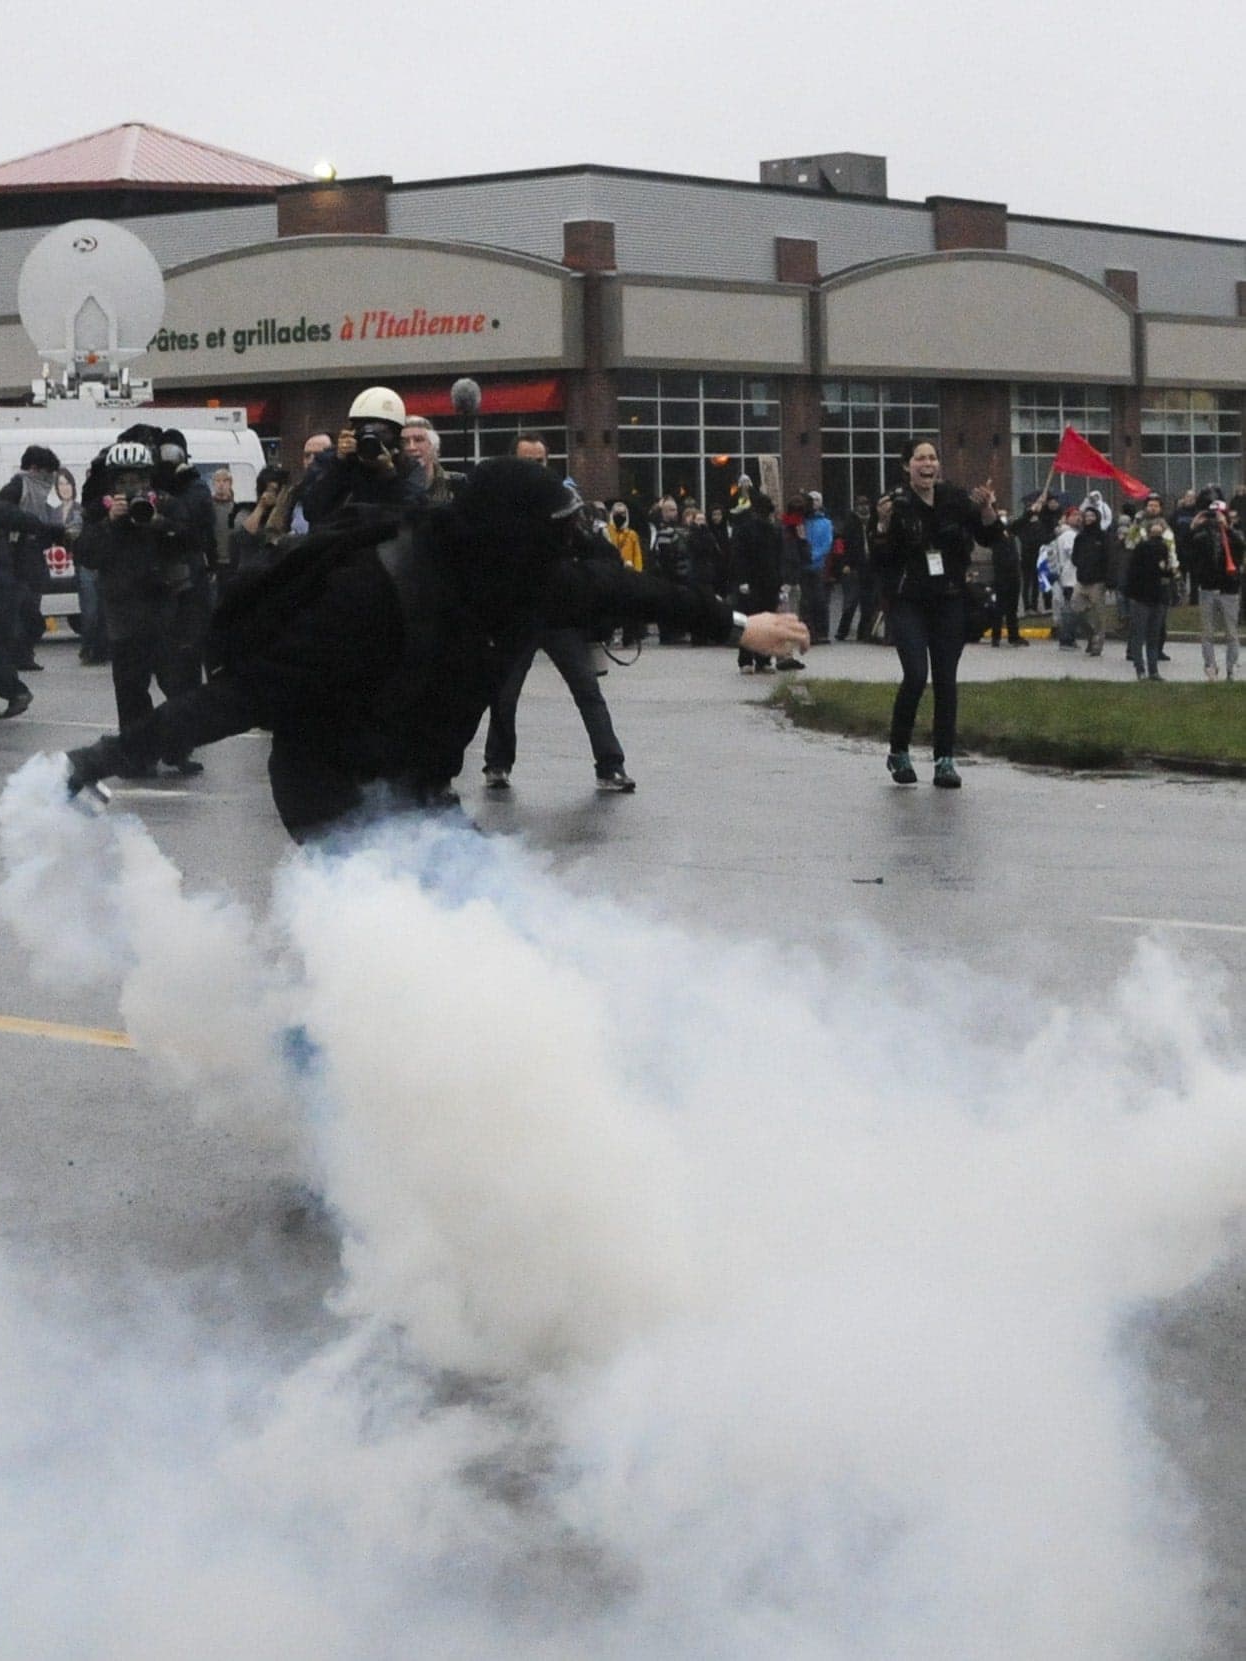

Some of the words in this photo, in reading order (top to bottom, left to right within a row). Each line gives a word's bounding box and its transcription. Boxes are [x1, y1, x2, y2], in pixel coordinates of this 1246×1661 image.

[205, 327, 226, 349] et
[232, 316, 331, 354] grillades
[339, 314, 355, 342] à
[360, 307, 486, 341] l'Italienne
